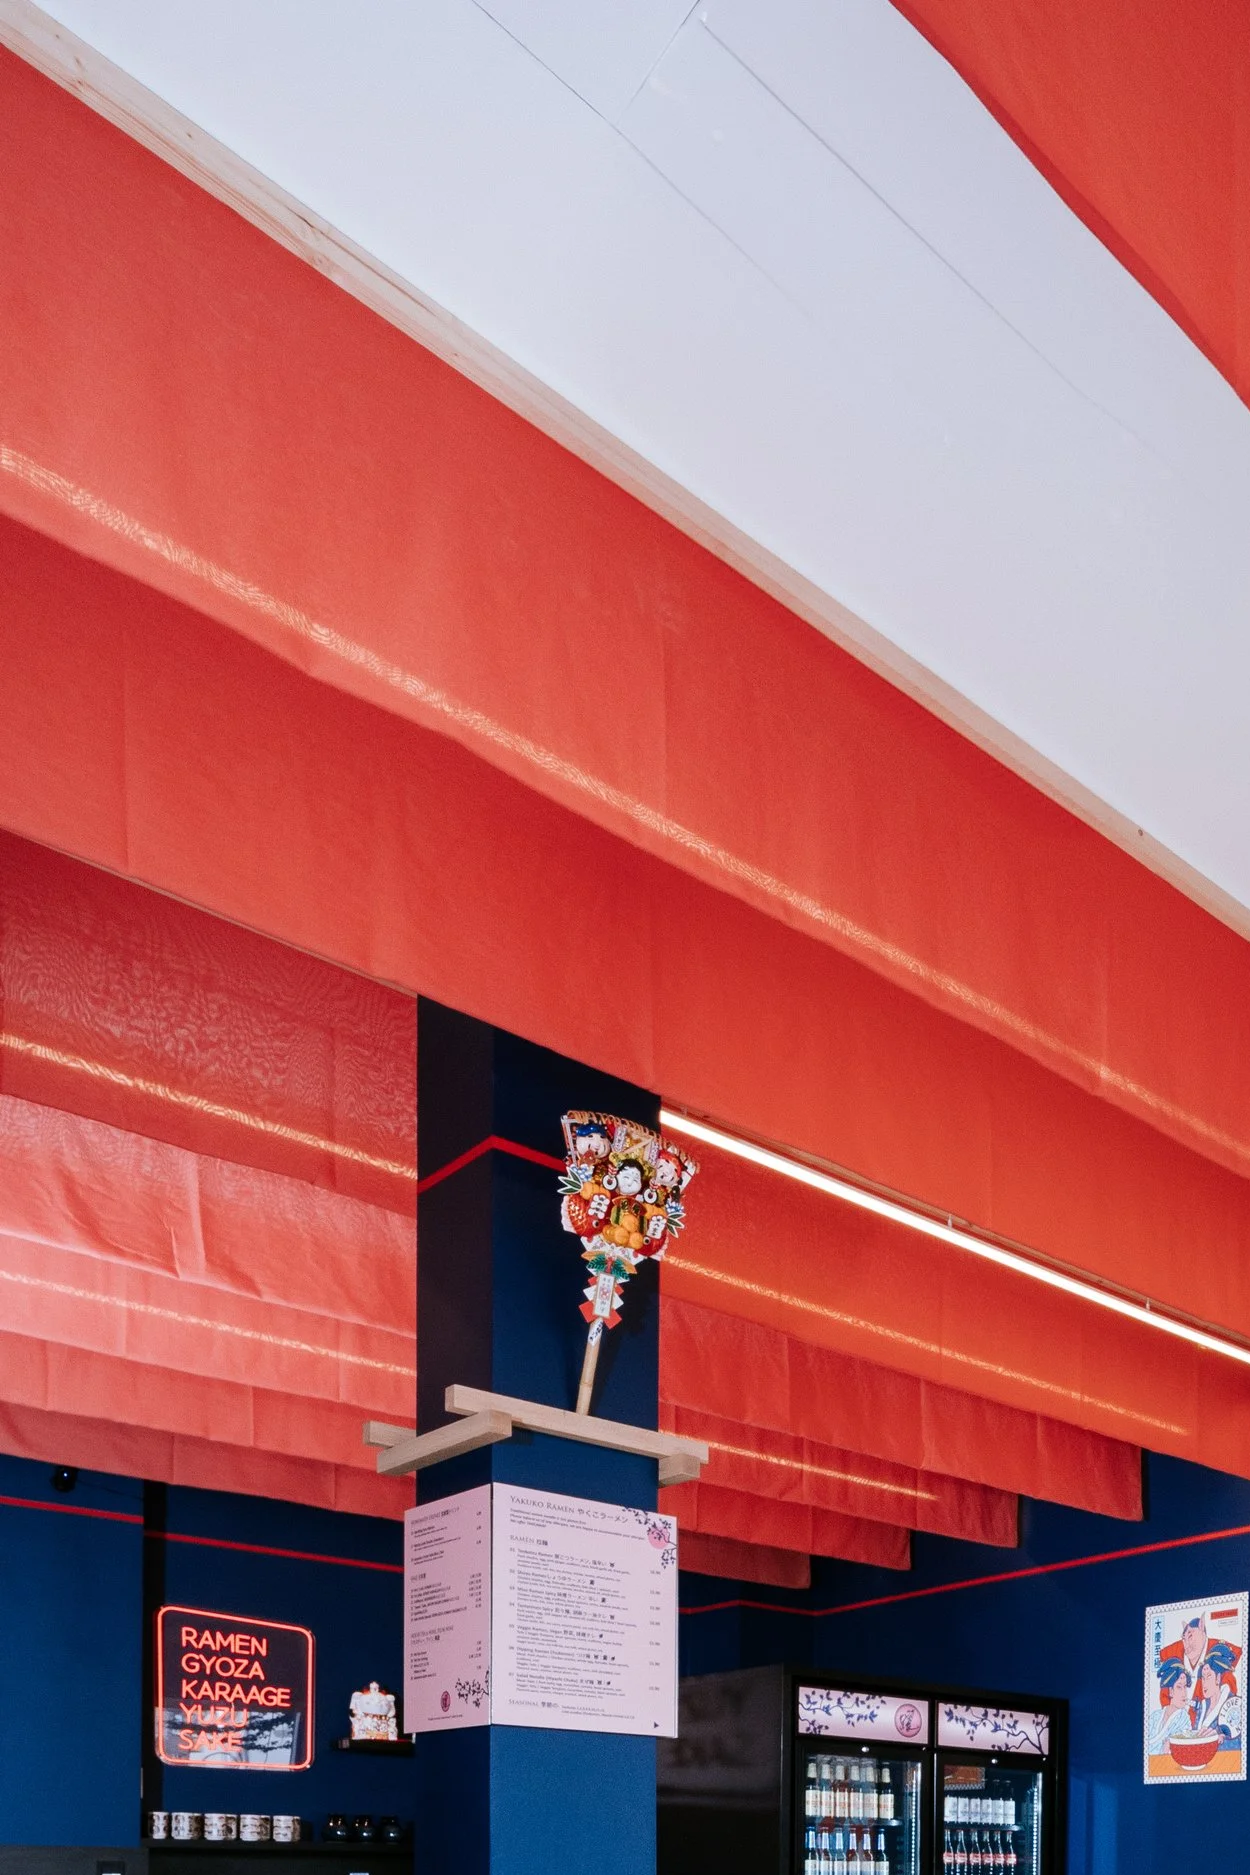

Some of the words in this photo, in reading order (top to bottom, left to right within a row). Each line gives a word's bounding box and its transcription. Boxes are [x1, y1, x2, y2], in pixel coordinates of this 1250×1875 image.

[510, 1495, 544, 1509] YAKUKO
[547, 1502, 575, 1514] RAMEN
[578, 1508, 629, 1524] やくこラーメン
[510, 1535, 535, 1544] RAMEN
[181, 1626, 267, 1657] RAMEN
[181, 1653, 265, 1681] GYOZA
[181, 1679, 291, 1707] KARAAGE
[1222, 1697, 1239, 1713] LOVE
[179, 1702, 249, 1729] YUZU
[178, 1728, 243, 1752] SAKE
